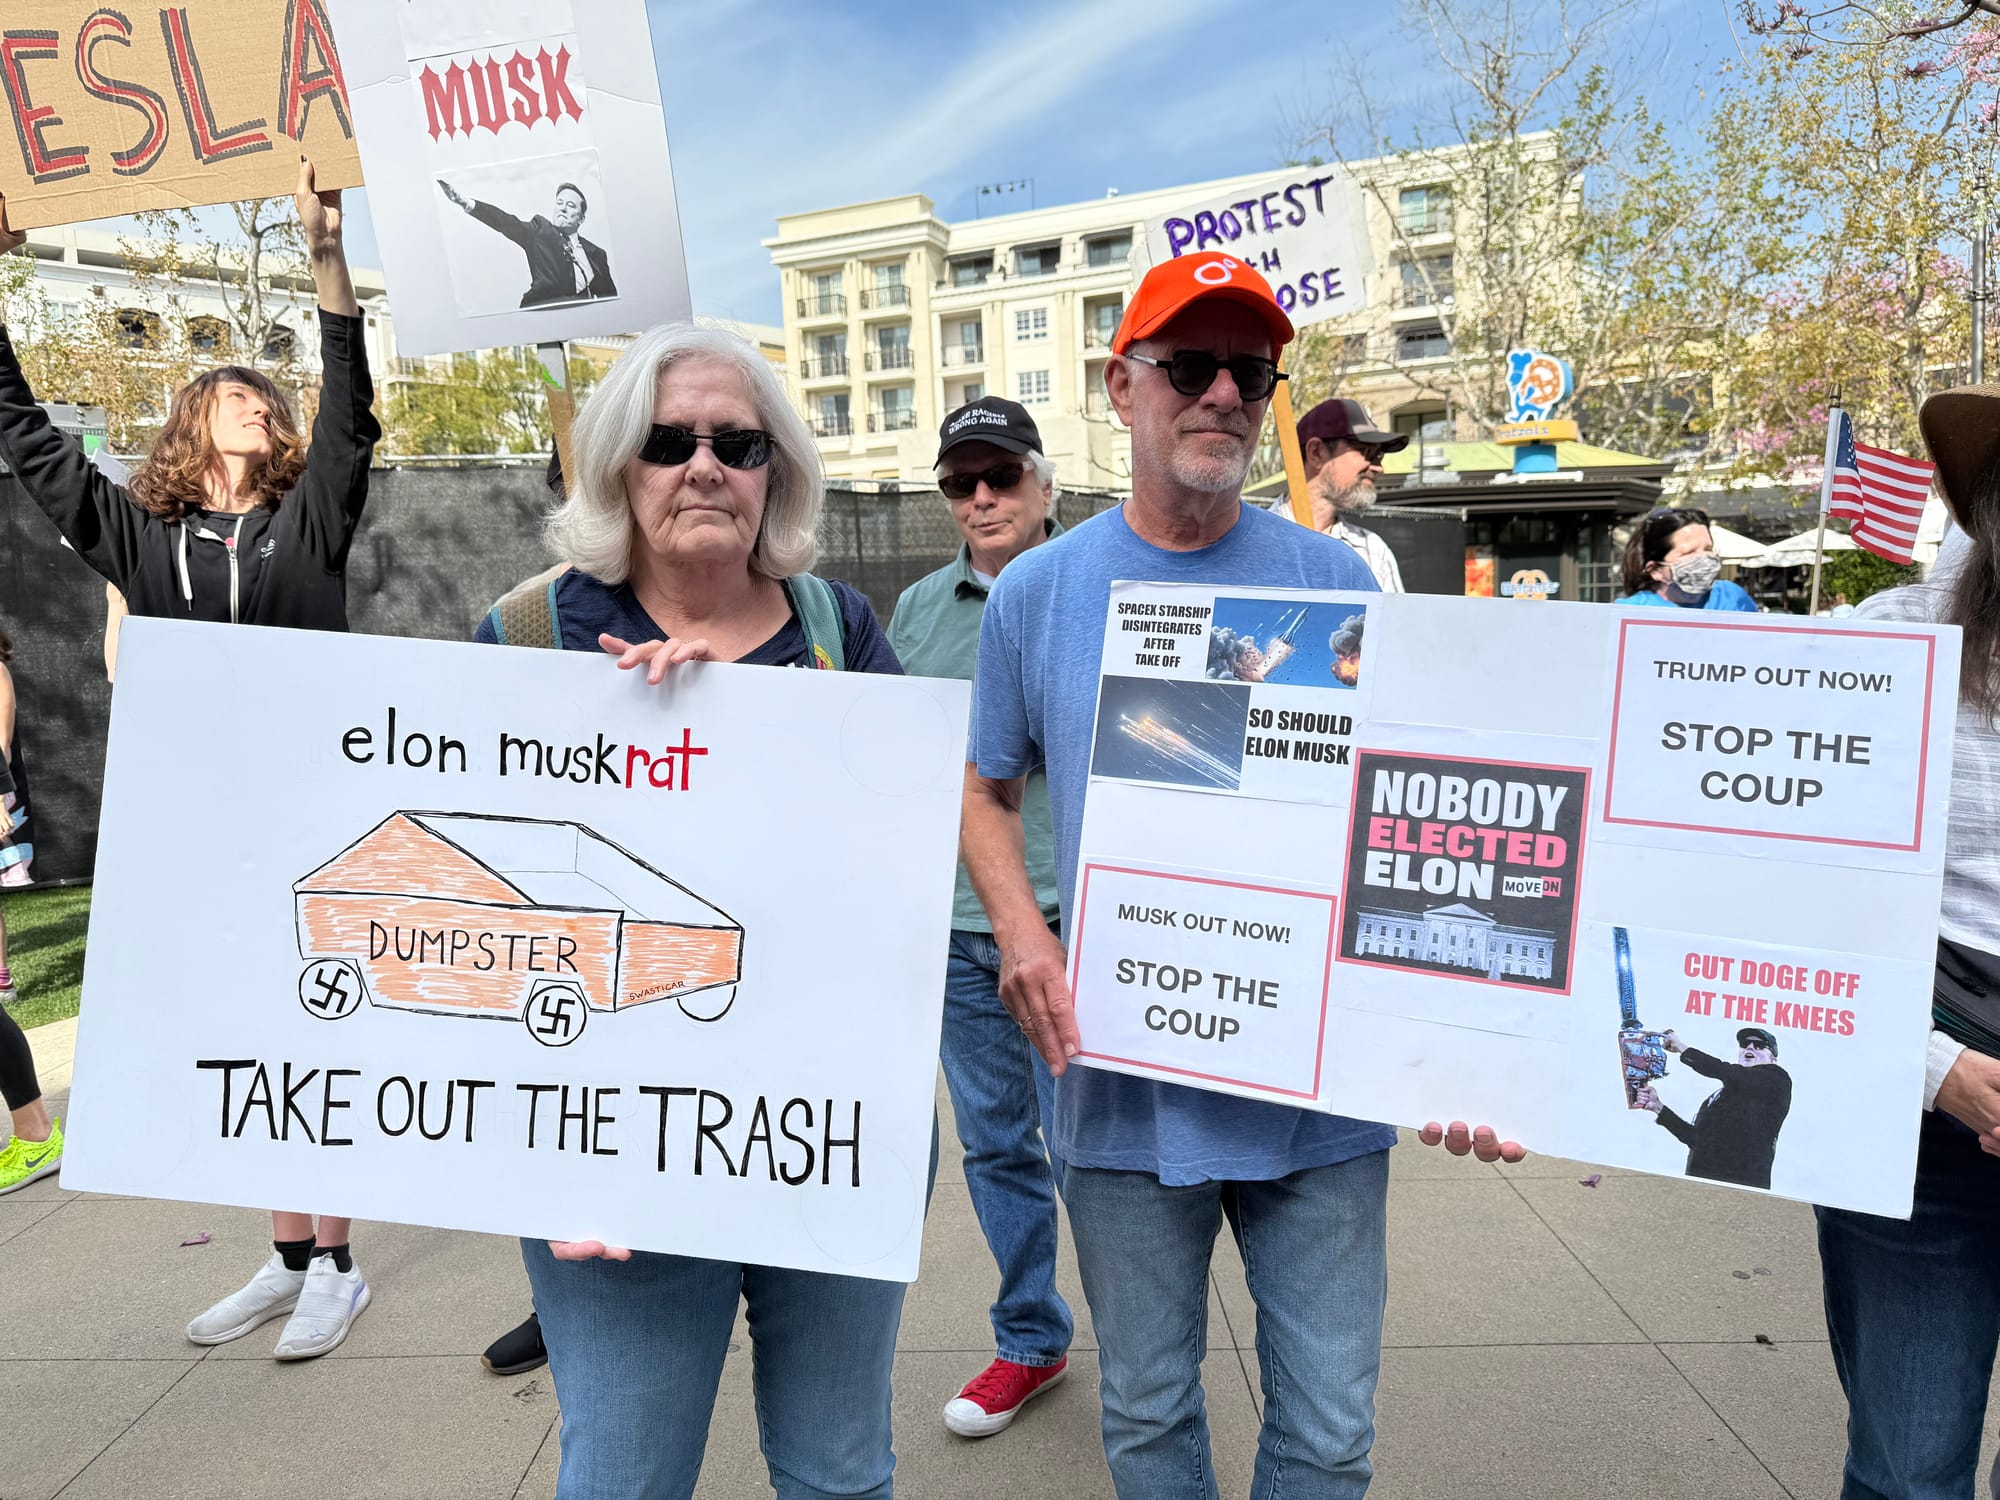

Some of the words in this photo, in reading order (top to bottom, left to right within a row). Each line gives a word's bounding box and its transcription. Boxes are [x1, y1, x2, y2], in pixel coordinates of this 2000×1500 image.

[418, 42, 584, 144] MUSK
[1163, 175, 1334, 259] PROTEST
[979, 416, 1008, 427] AGAIN
[1117, 602, 1157, 616] SPACEX
[1158, 604, 1211, 620] STARSHIP
[1121, 619, 1202, 636] DISINTEGRATES
[1135, 652, 1160, 667] TAKE
[1161, 655, 1182, 668] OFF
[1143, 637, 1176, 651] AFTER
[1653, 660, 1747, 683] TRUMP
[1754, 666, 1811, 688] OUT
[1818, 670, 1892, 693] NOW!
[1249, 707, 1274, 729] SO
[1277, 710, 1354, 736] SHOULD
[341, 706, 467, 773] elon
[499, 727, 709, 791] muskrat
[1245, 736, 1290, 760] ELON
[1293, 740, 1351, 766] MUSK
[1661, 721, 1773, 757] STOP
[1786, 730, 1872, 766] THE
[1371, 769, 1569, 832] NOBODY
[1700, 770, 1823, 807] COUP
[1367, 816, 1567, 868] ELECTED
[1364, 850, 1495, 901] ELON
[1117, 903, 1178, 928] MUSK
[1183, 913, 1228, 934] OUT
[1232, 919, 1291, 944] NOW!
[369, 919, 578, 974] DUMPSTER
[629, 980, 686, 1001] SWASTICAR
[1115, 958, 1203, 994] STOP
[1212, 972, 1280, 1009] THE
[1683, 952, 1735, 982] CUT
[1739, 958, 1809, 993] DOGE
[1814, 969, 1861, 999] OFF
[1144, 1004, 1240, 1043] COUP
[1684, 989, 1718, 1017] AT
[1721, 993, 1769, 1025] THE
[1773, 1002, 1856, 1037] KNEES
[196, 1058, 361, 1147] TAKE
[376, 1075, 496, 1144] OUT
[515, 1083, 621, 1157] THE
[638, 1084, 862, 1188] TRASH
